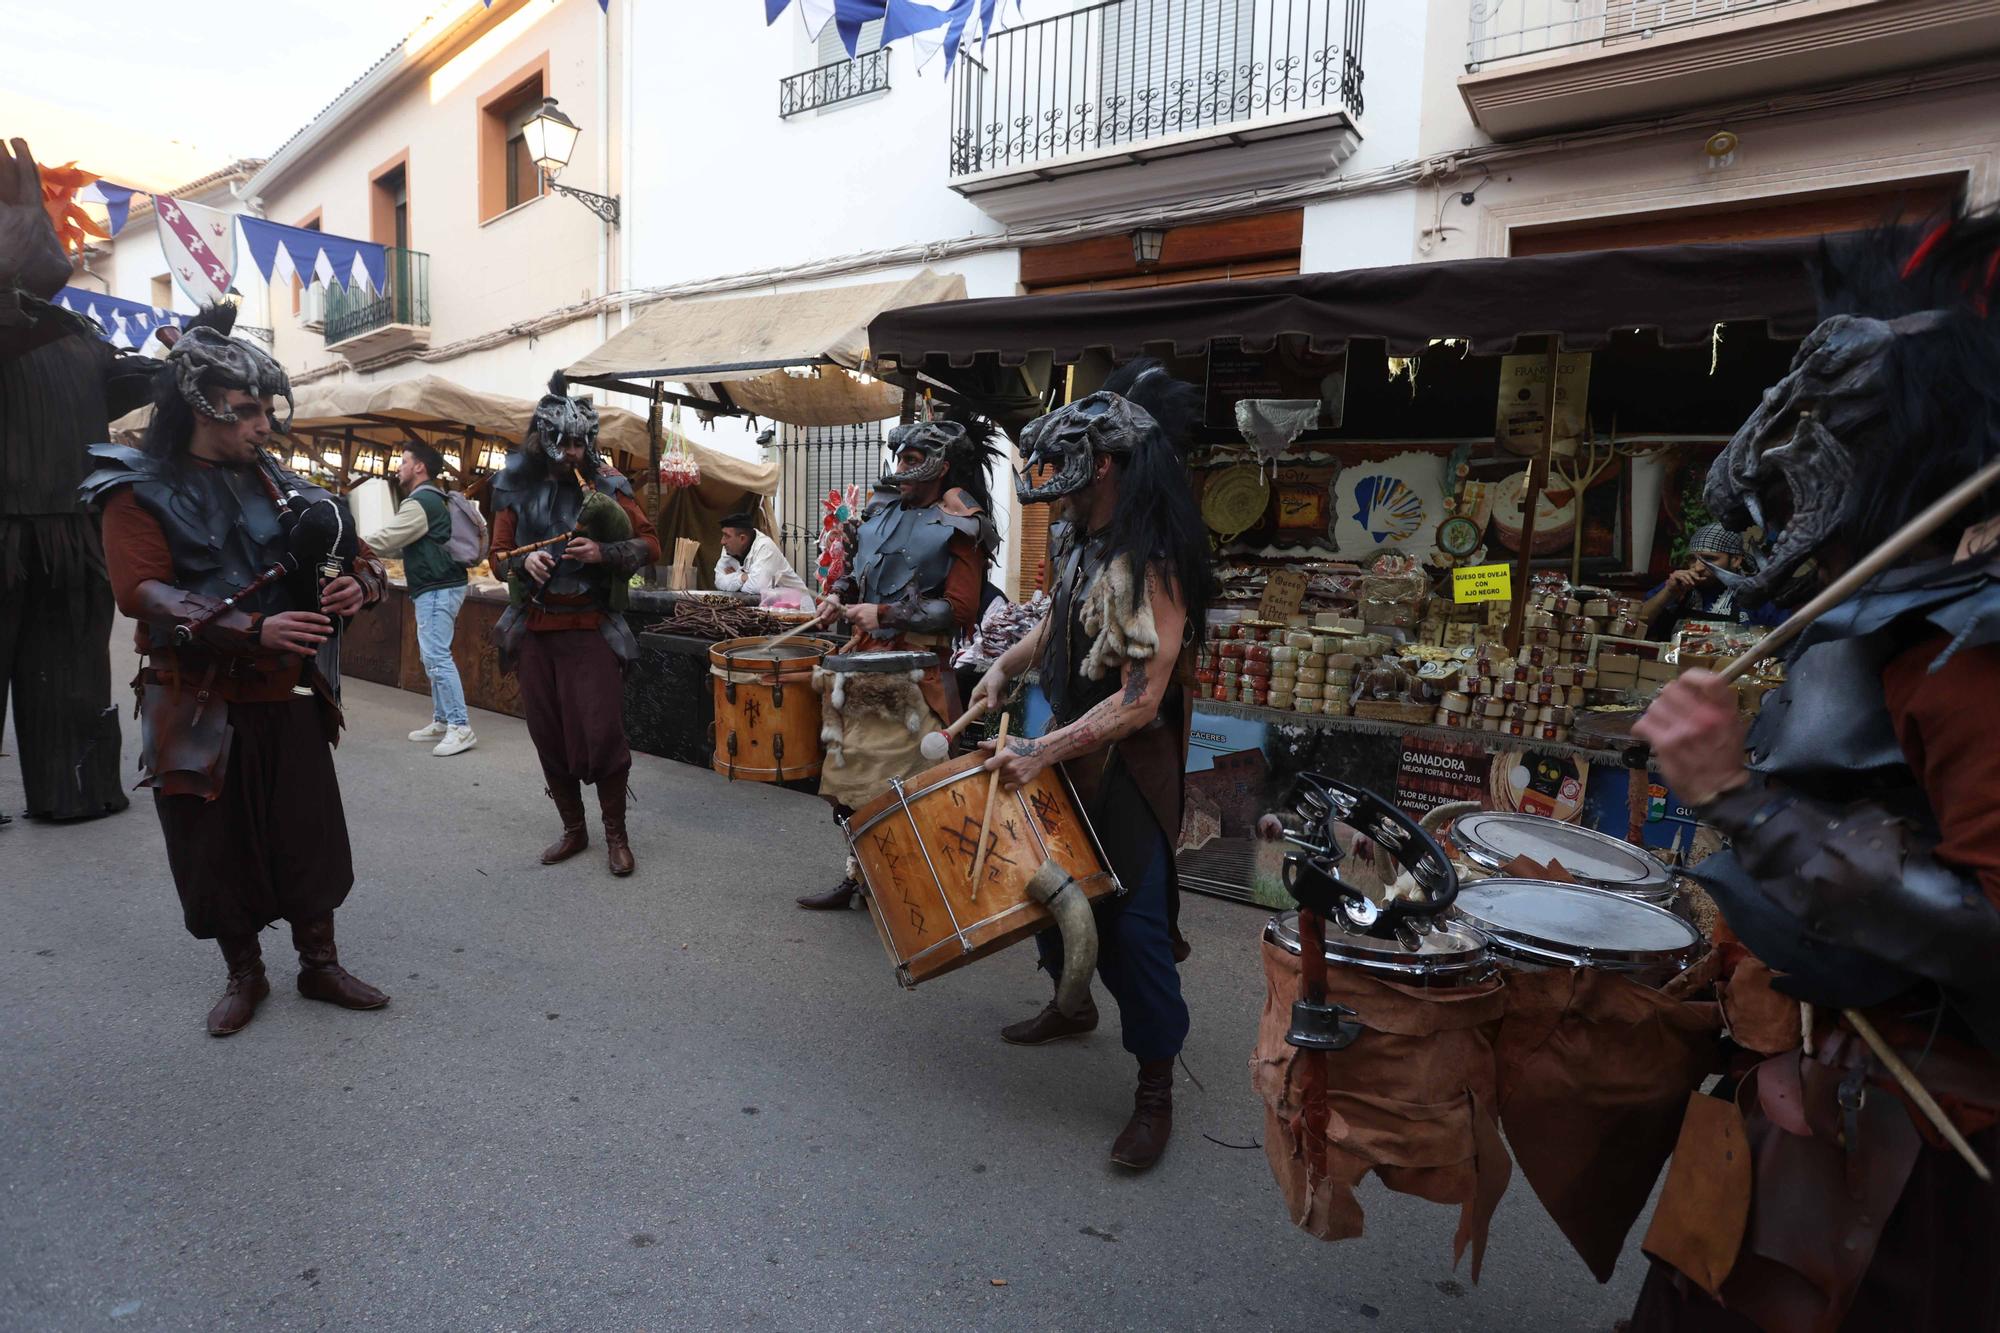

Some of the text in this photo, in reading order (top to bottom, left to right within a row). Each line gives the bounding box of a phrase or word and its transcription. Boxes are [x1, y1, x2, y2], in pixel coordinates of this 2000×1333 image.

[1478, 588, 1500, 596] NEGRO
[1403, 752, 1465, 771] GANADORA
[1402, 764, 1423, 773] MEJOR
[1425, 768, 1444, 777] TORTA
[1464, 774, 1481, 783] 2015
[1418, 793, 1427, 801] DE
[1428, 795, 1436, 803] LA
[1402, 800, 1429, 811] ANTAÑO
